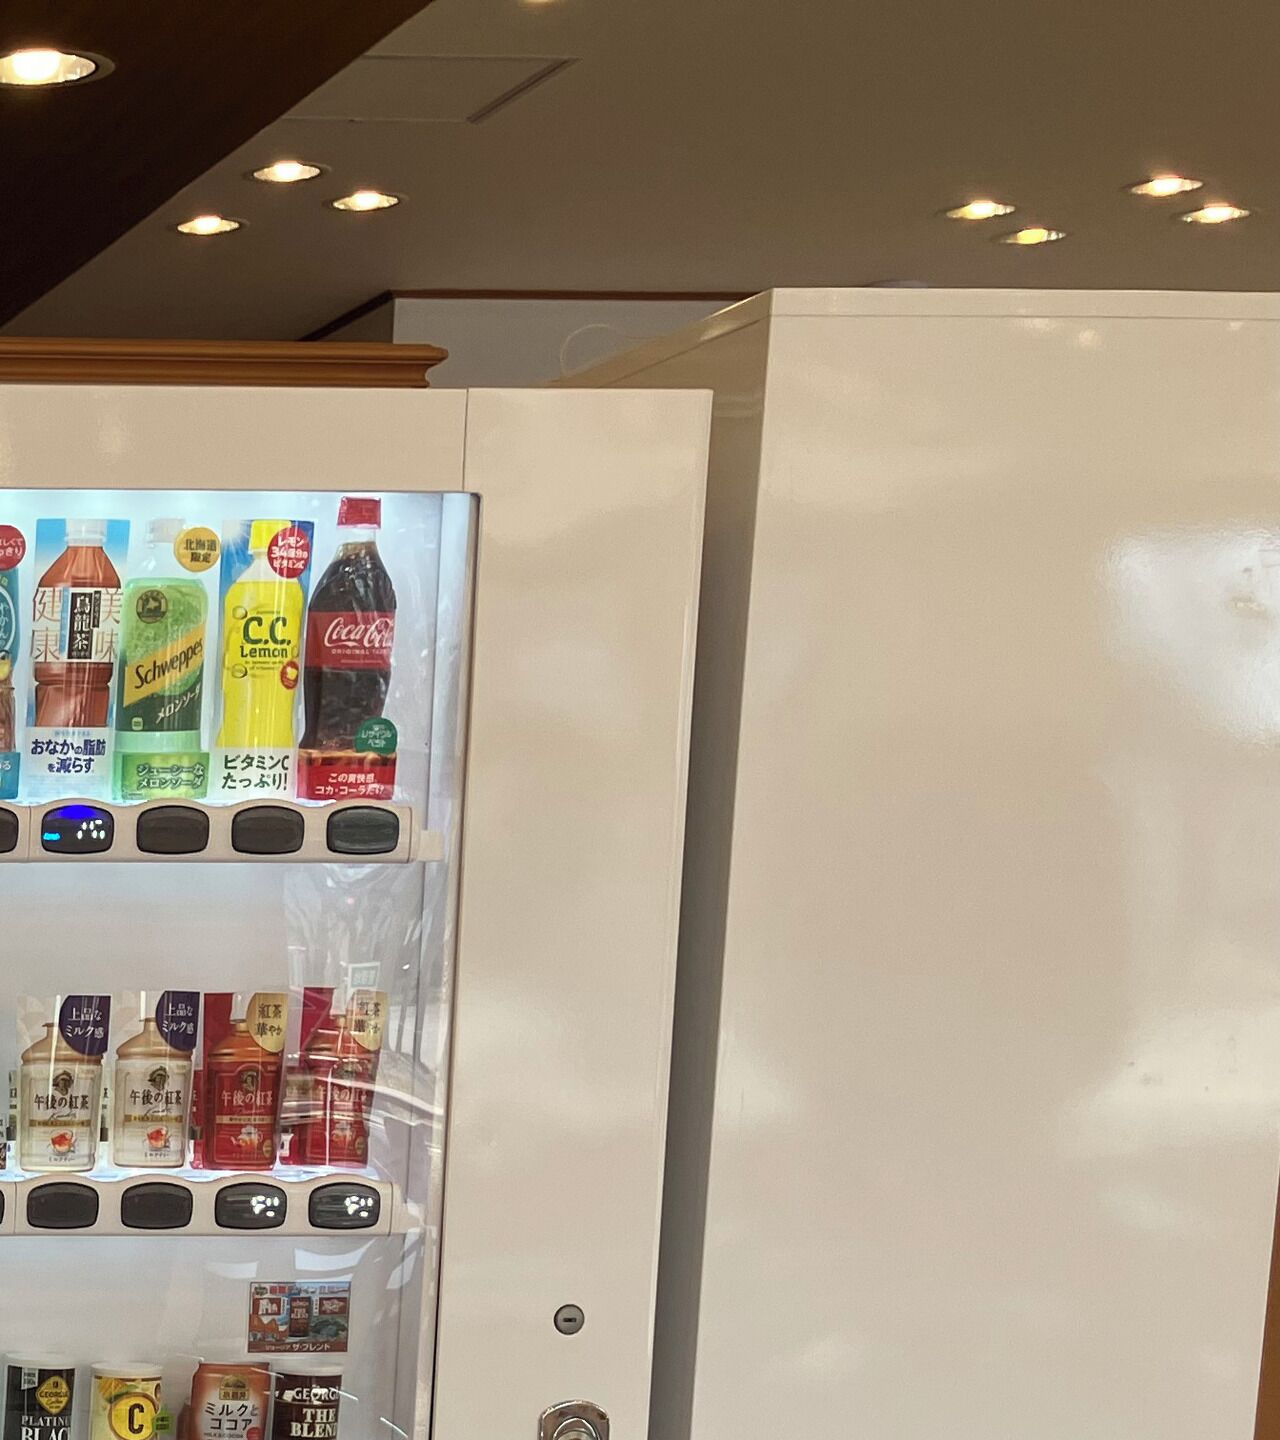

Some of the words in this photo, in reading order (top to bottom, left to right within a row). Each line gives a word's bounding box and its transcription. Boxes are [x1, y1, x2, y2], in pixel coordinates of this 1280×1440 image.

[183, 539, 216, 551] 北海道
[277, 536, 305, 546] レモン
[242, 616, 291, 645] C.C.
[240, 645, 288, 658] Lemon
[30, 739, 106, 756] おなかの脂肪
[138, 764, 204, 776] ジューシーな
[224, 755, 289, 771] ビタミンC
[138, 777, 204, 789] メロンソーダ
[222, 772, 288, 791] たっぷり!
[68, 1008, 103, 1021] 上品な
[164, 1003, 193, 1016] 上品な
[257, 1004, 282, 1018] 紅茶
[65, 1026, 105, 1039] ミルク感
[161, 1021, 195, 1033] ミルク感
[34, 1094, 90, 1111] 午後の紅茶
[129, 1089, 182, 1106] 午後の紅茶
[221, 1090, 273, 1107] 午後の紅茶
[205, 1402, 259, 1416] ミルクと
[303, 1407, 336, 1424] THE
[128, 1403, 145, 1435] C
[210, 1418, 253, 1430] ココア
